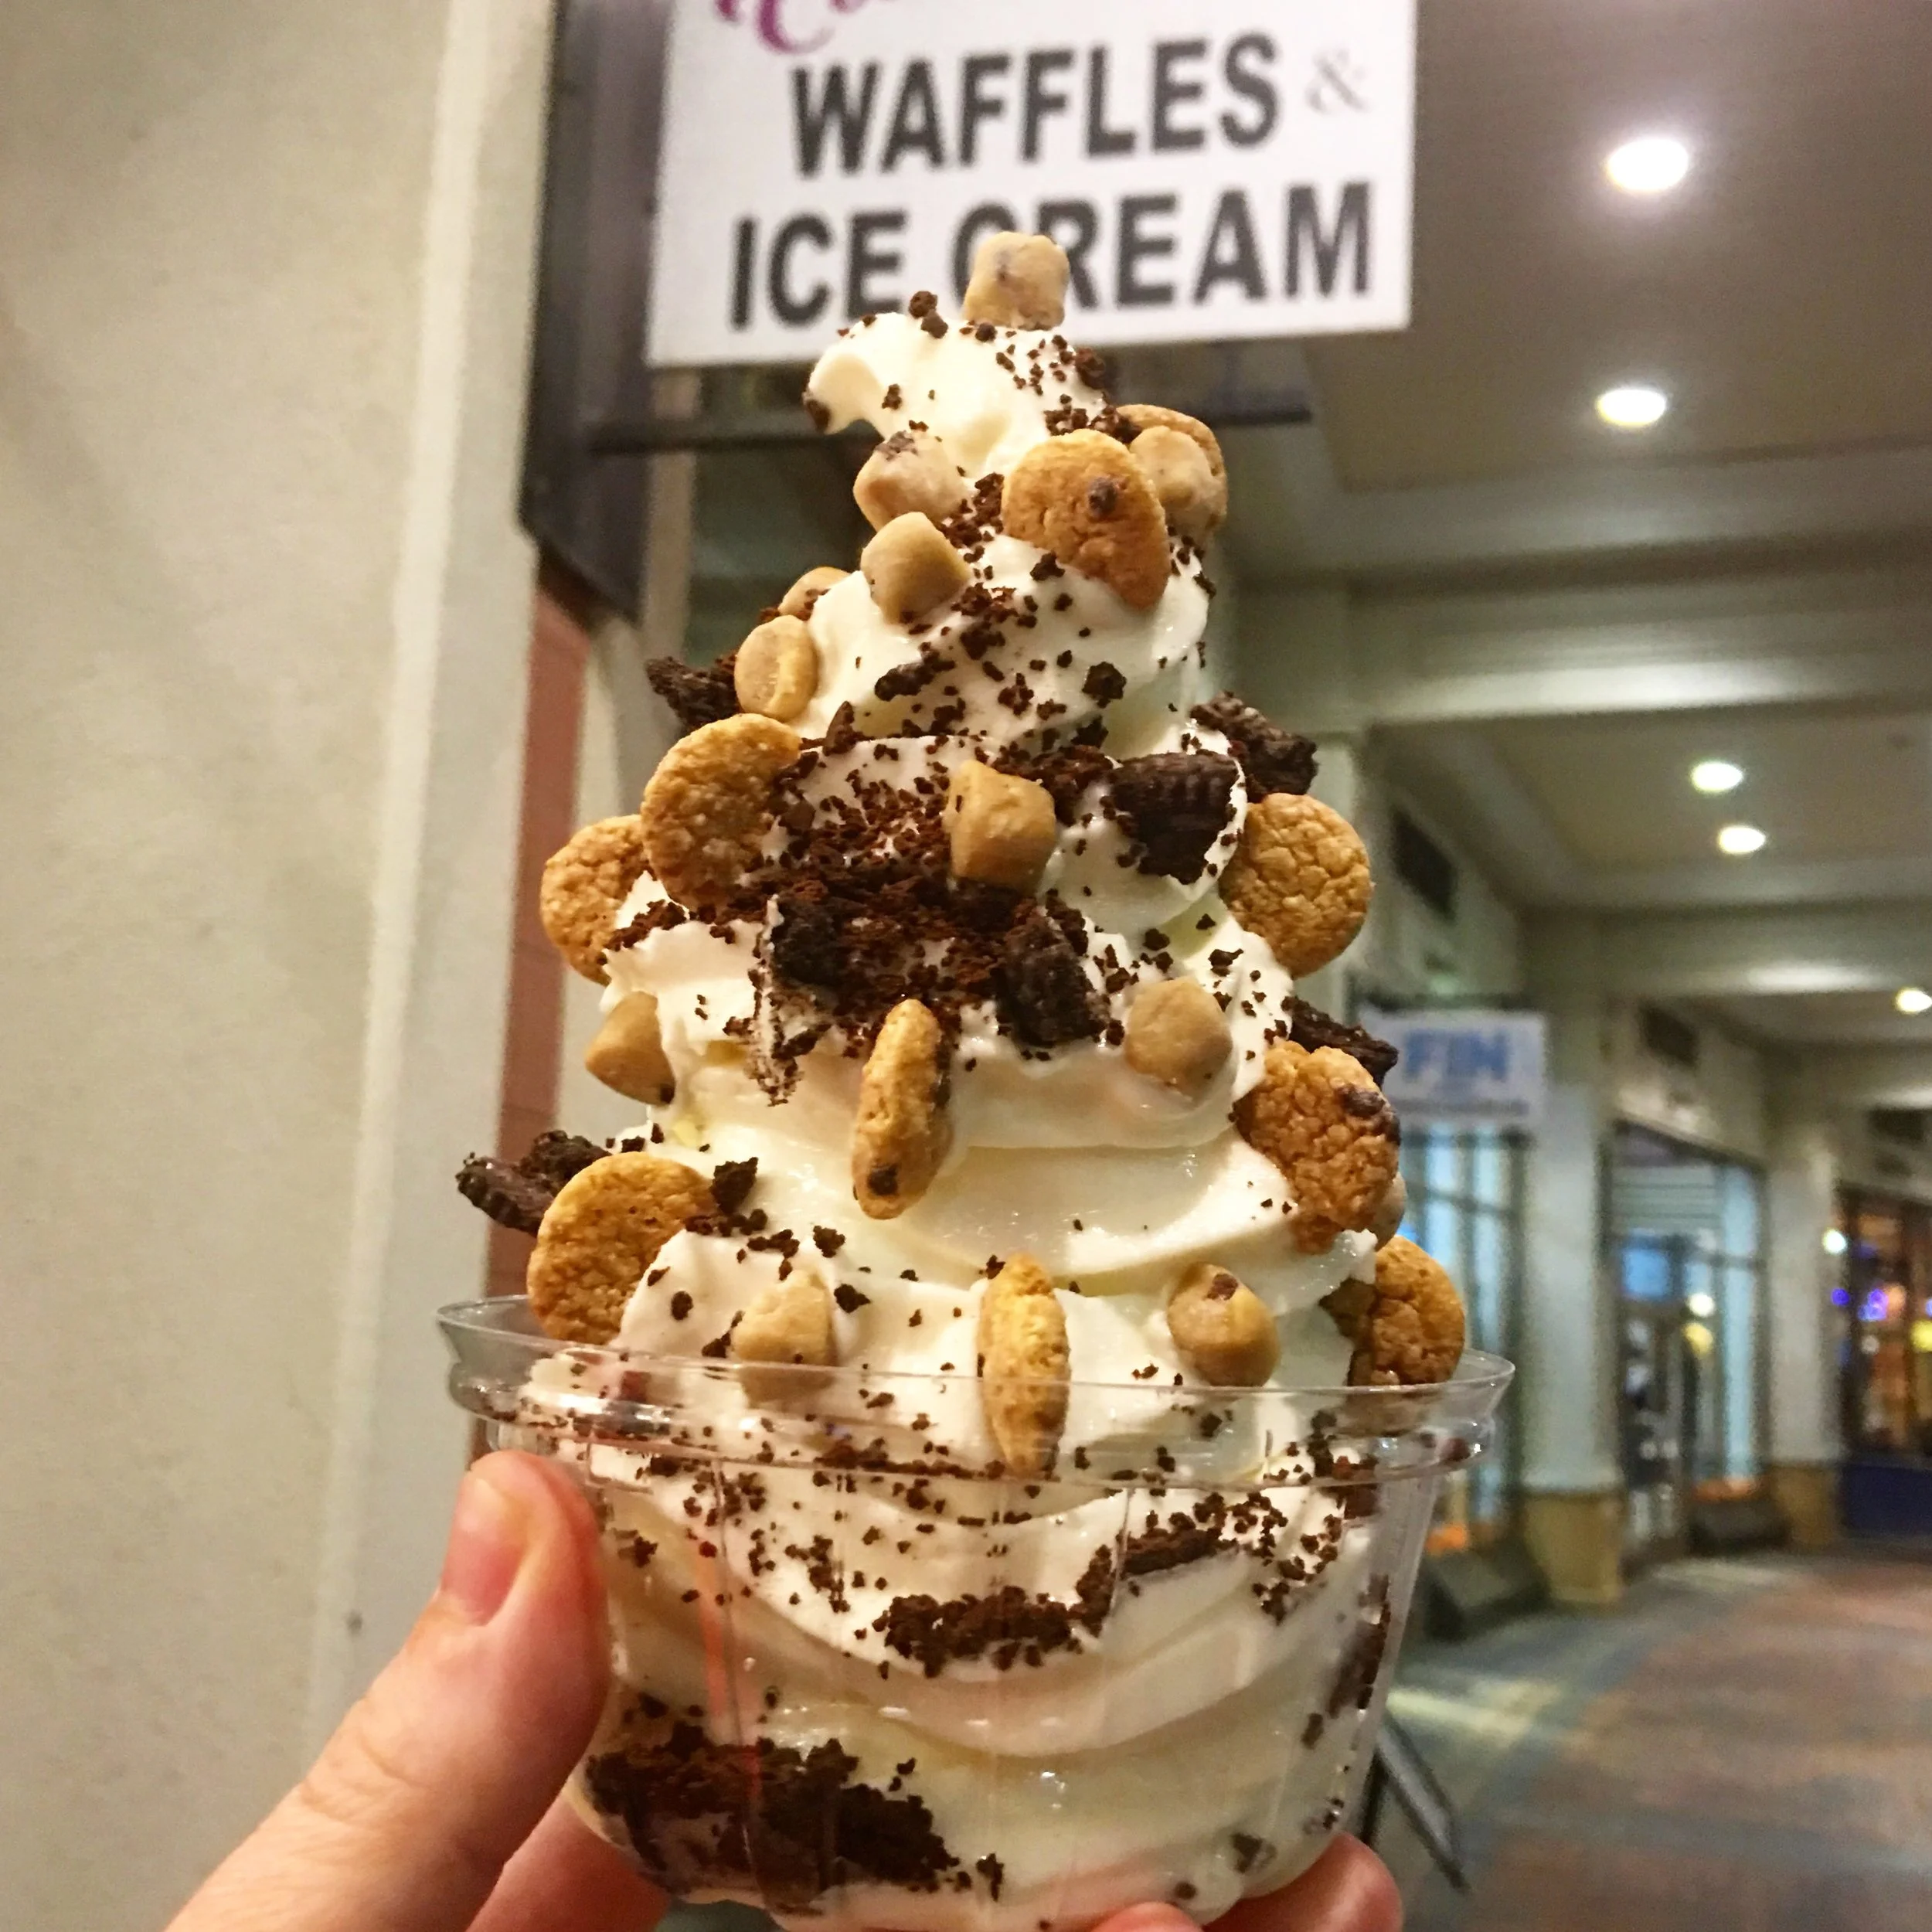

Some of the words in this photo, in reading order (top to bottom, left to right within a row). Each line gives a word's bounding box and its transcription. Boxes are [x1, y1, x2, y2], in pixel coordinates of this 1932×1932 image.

[791, 31, 1283, 179] WAFFLES
[1305, 50, 1371, 114] &
[730, 209, 909, 331] ICE
